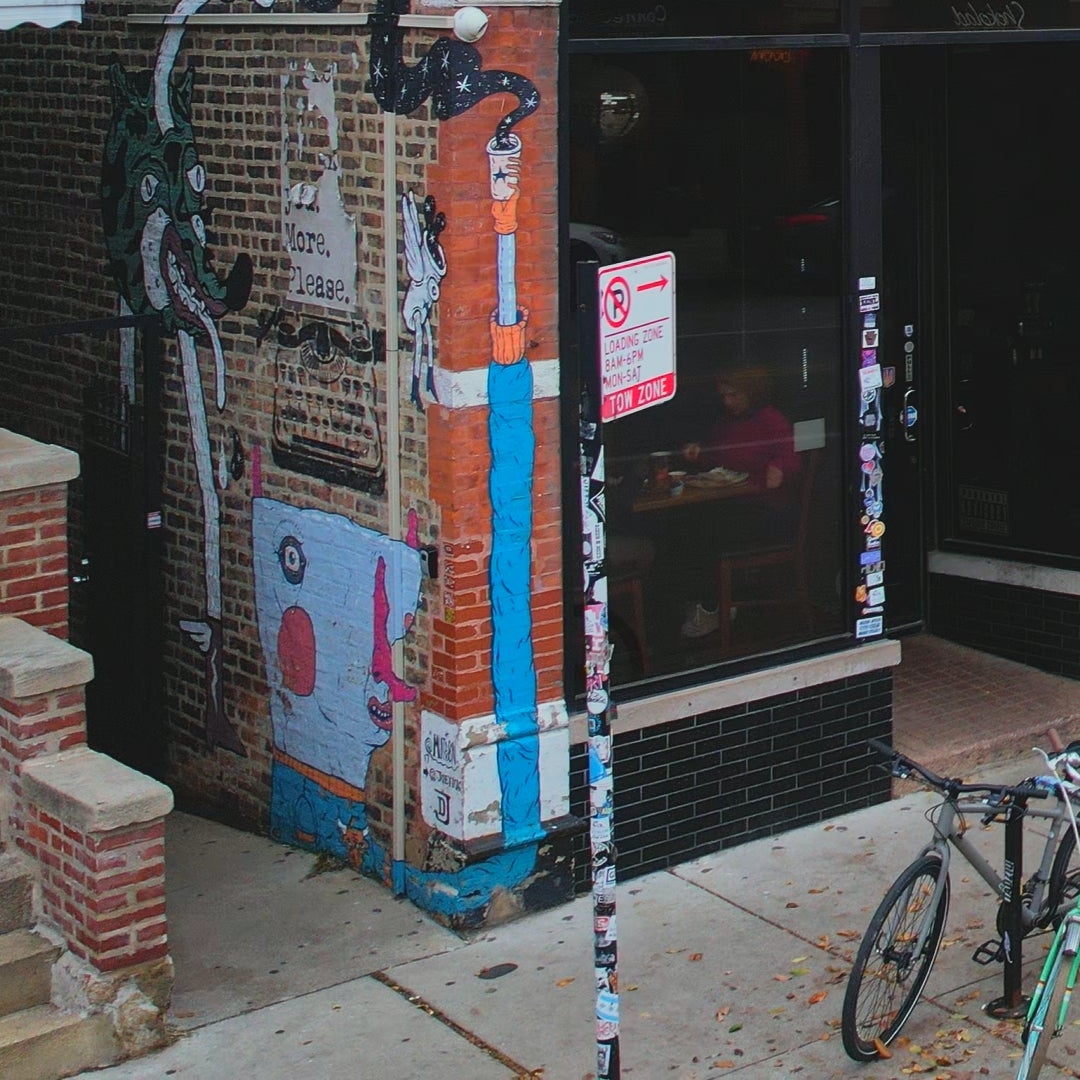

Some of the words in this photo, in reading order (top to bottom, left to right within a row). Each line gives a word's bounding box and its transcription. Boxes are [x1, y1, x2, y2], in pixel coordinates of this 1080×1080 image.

[285, 223, 330, 258] More.
[604, 335, 639, 355] LOADING
[643, 326, 664, 344] ZONE
[605, 349, 644, 373] 8AM-6PM
[604, 366, 641, 389] MON-SAT
[610, 391, 634, 414] TOW
[638, 377, 667, 403] ZONE
